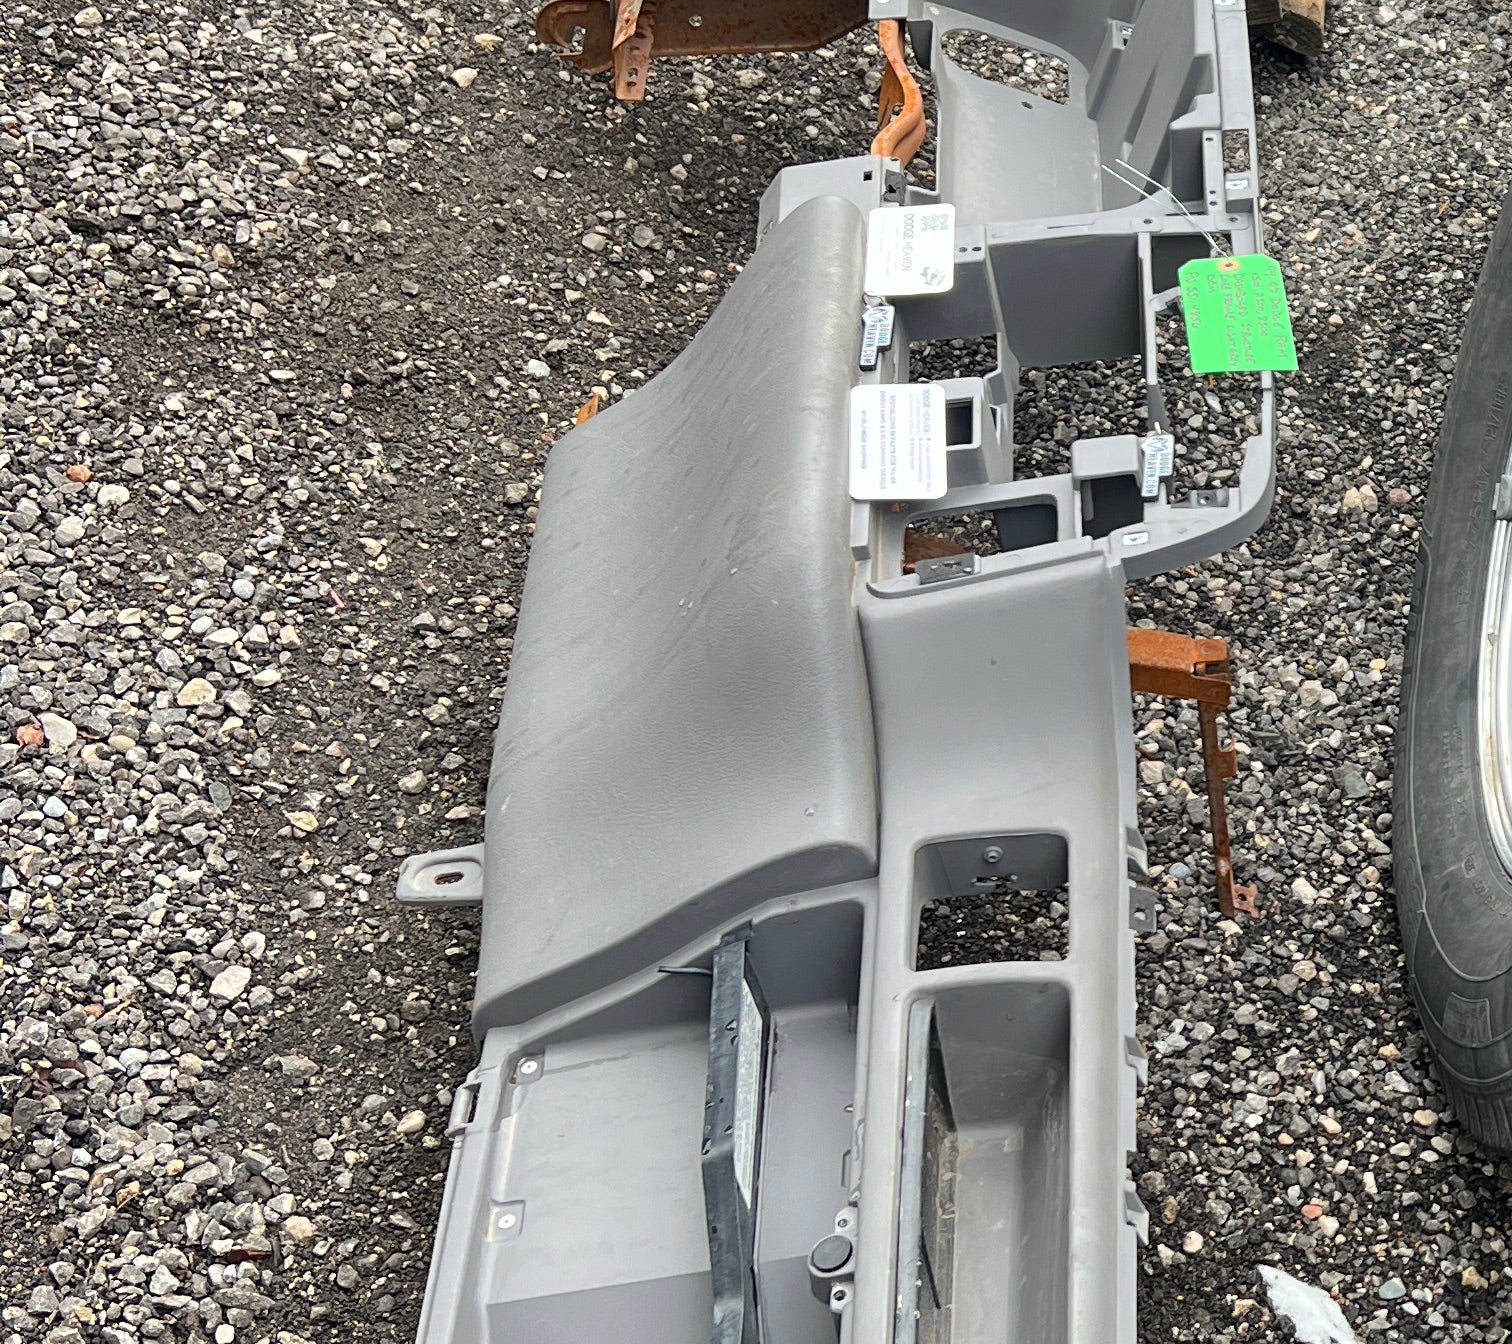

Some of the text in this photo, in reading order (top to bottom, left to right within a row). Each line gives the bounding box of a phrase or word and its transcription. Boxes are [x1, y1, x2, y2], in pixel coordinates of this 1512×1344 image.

[900, 213, 916, 272] DODGE HEAVEN
[862, 324, 878, 364] HEAVEN.COM
[877, 324, 890, 344] DODGE
[1274, 334, 1288, 358] RAM
[1144, 453, 1158, 495] HEAVEN.COM
[1159, 452, 1172, 474] DODGE
